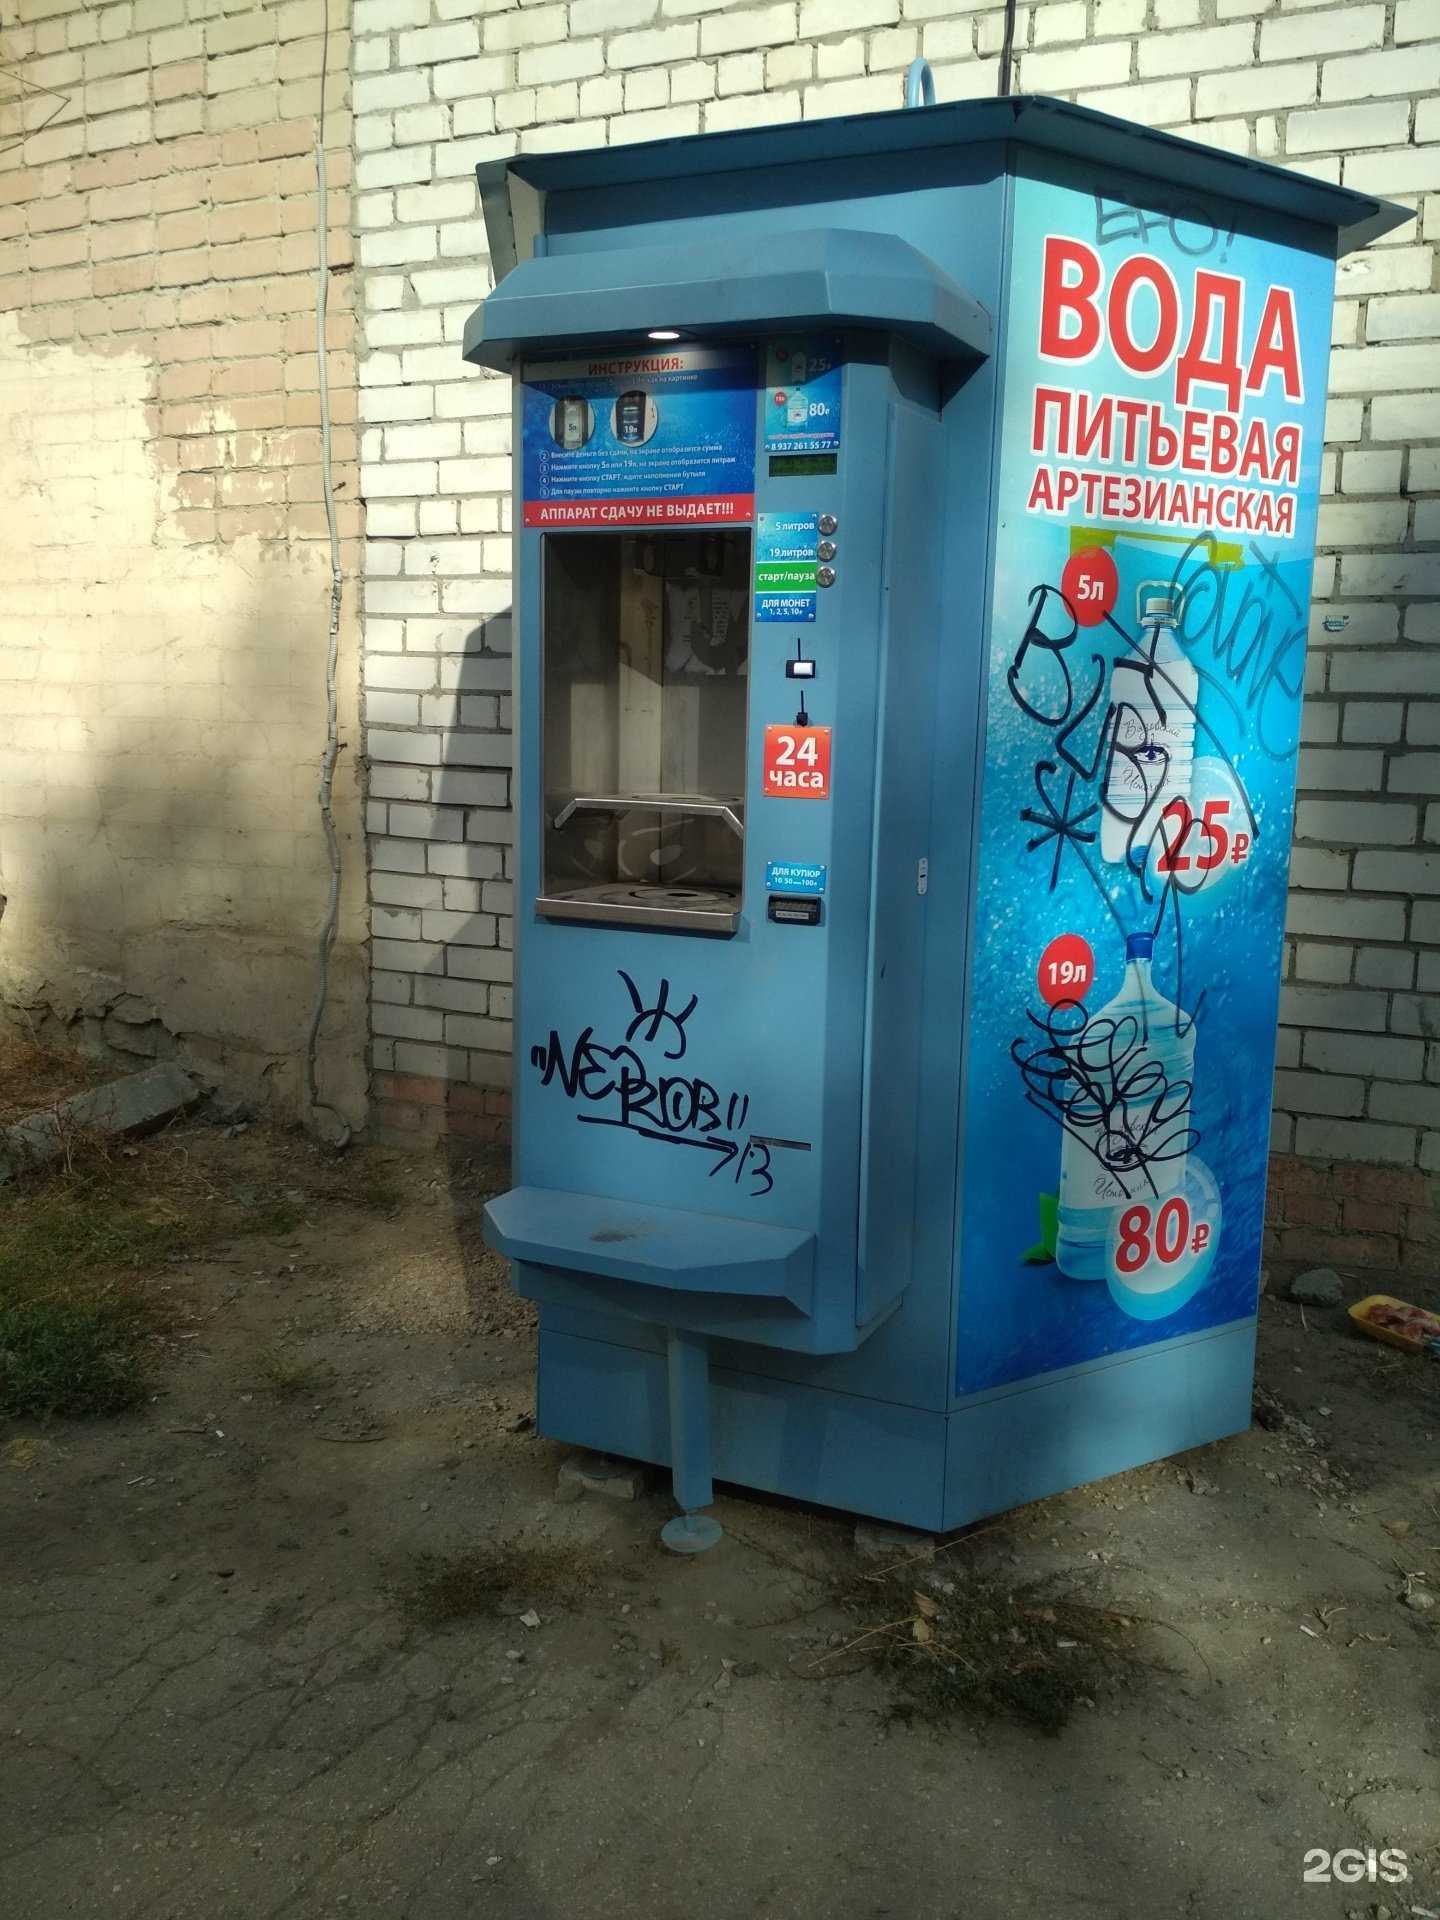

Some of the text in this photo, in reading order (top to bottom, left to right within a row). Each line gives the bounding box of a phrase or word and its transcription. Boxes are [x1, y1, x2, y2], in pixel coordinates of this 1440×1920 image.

[1039, 236, 1302, 413] ВОДА
[588, 357, 684, 375] ИНСТРУКЦИЯ:
[624, 426, 638, 434] 19л
[1033, 387, 1301, 483] ПИТЬЕВАЯ
[778, 442, 792, 450] 937
[820, 440, 831, 448] 77
[664, 483, 684, 491] СТАРТ
[1027, 468, 1294, 534] АРТЕЗИАНСКАЯ
[540, 502, 734, 521] АППАРАТ СДАЧУ НЕ ВЫДАЕТ!!!
[776, 522, 815, 532] 5 литров
[770, 548, 814, 558] 19 литров
[758, 571, 816, 583] старт/пауза
[1076, 574, 1105, 601] 5л
[762, 598, 811, 609] ДЛЯ МОНЕТ
[775, 735, 819, 767] 24
[768, 769, 824, 788] часа
[772, 866, 821, 878] ДЛЯ КУПЮР
[1047, 959, 1087, 985] 19л
